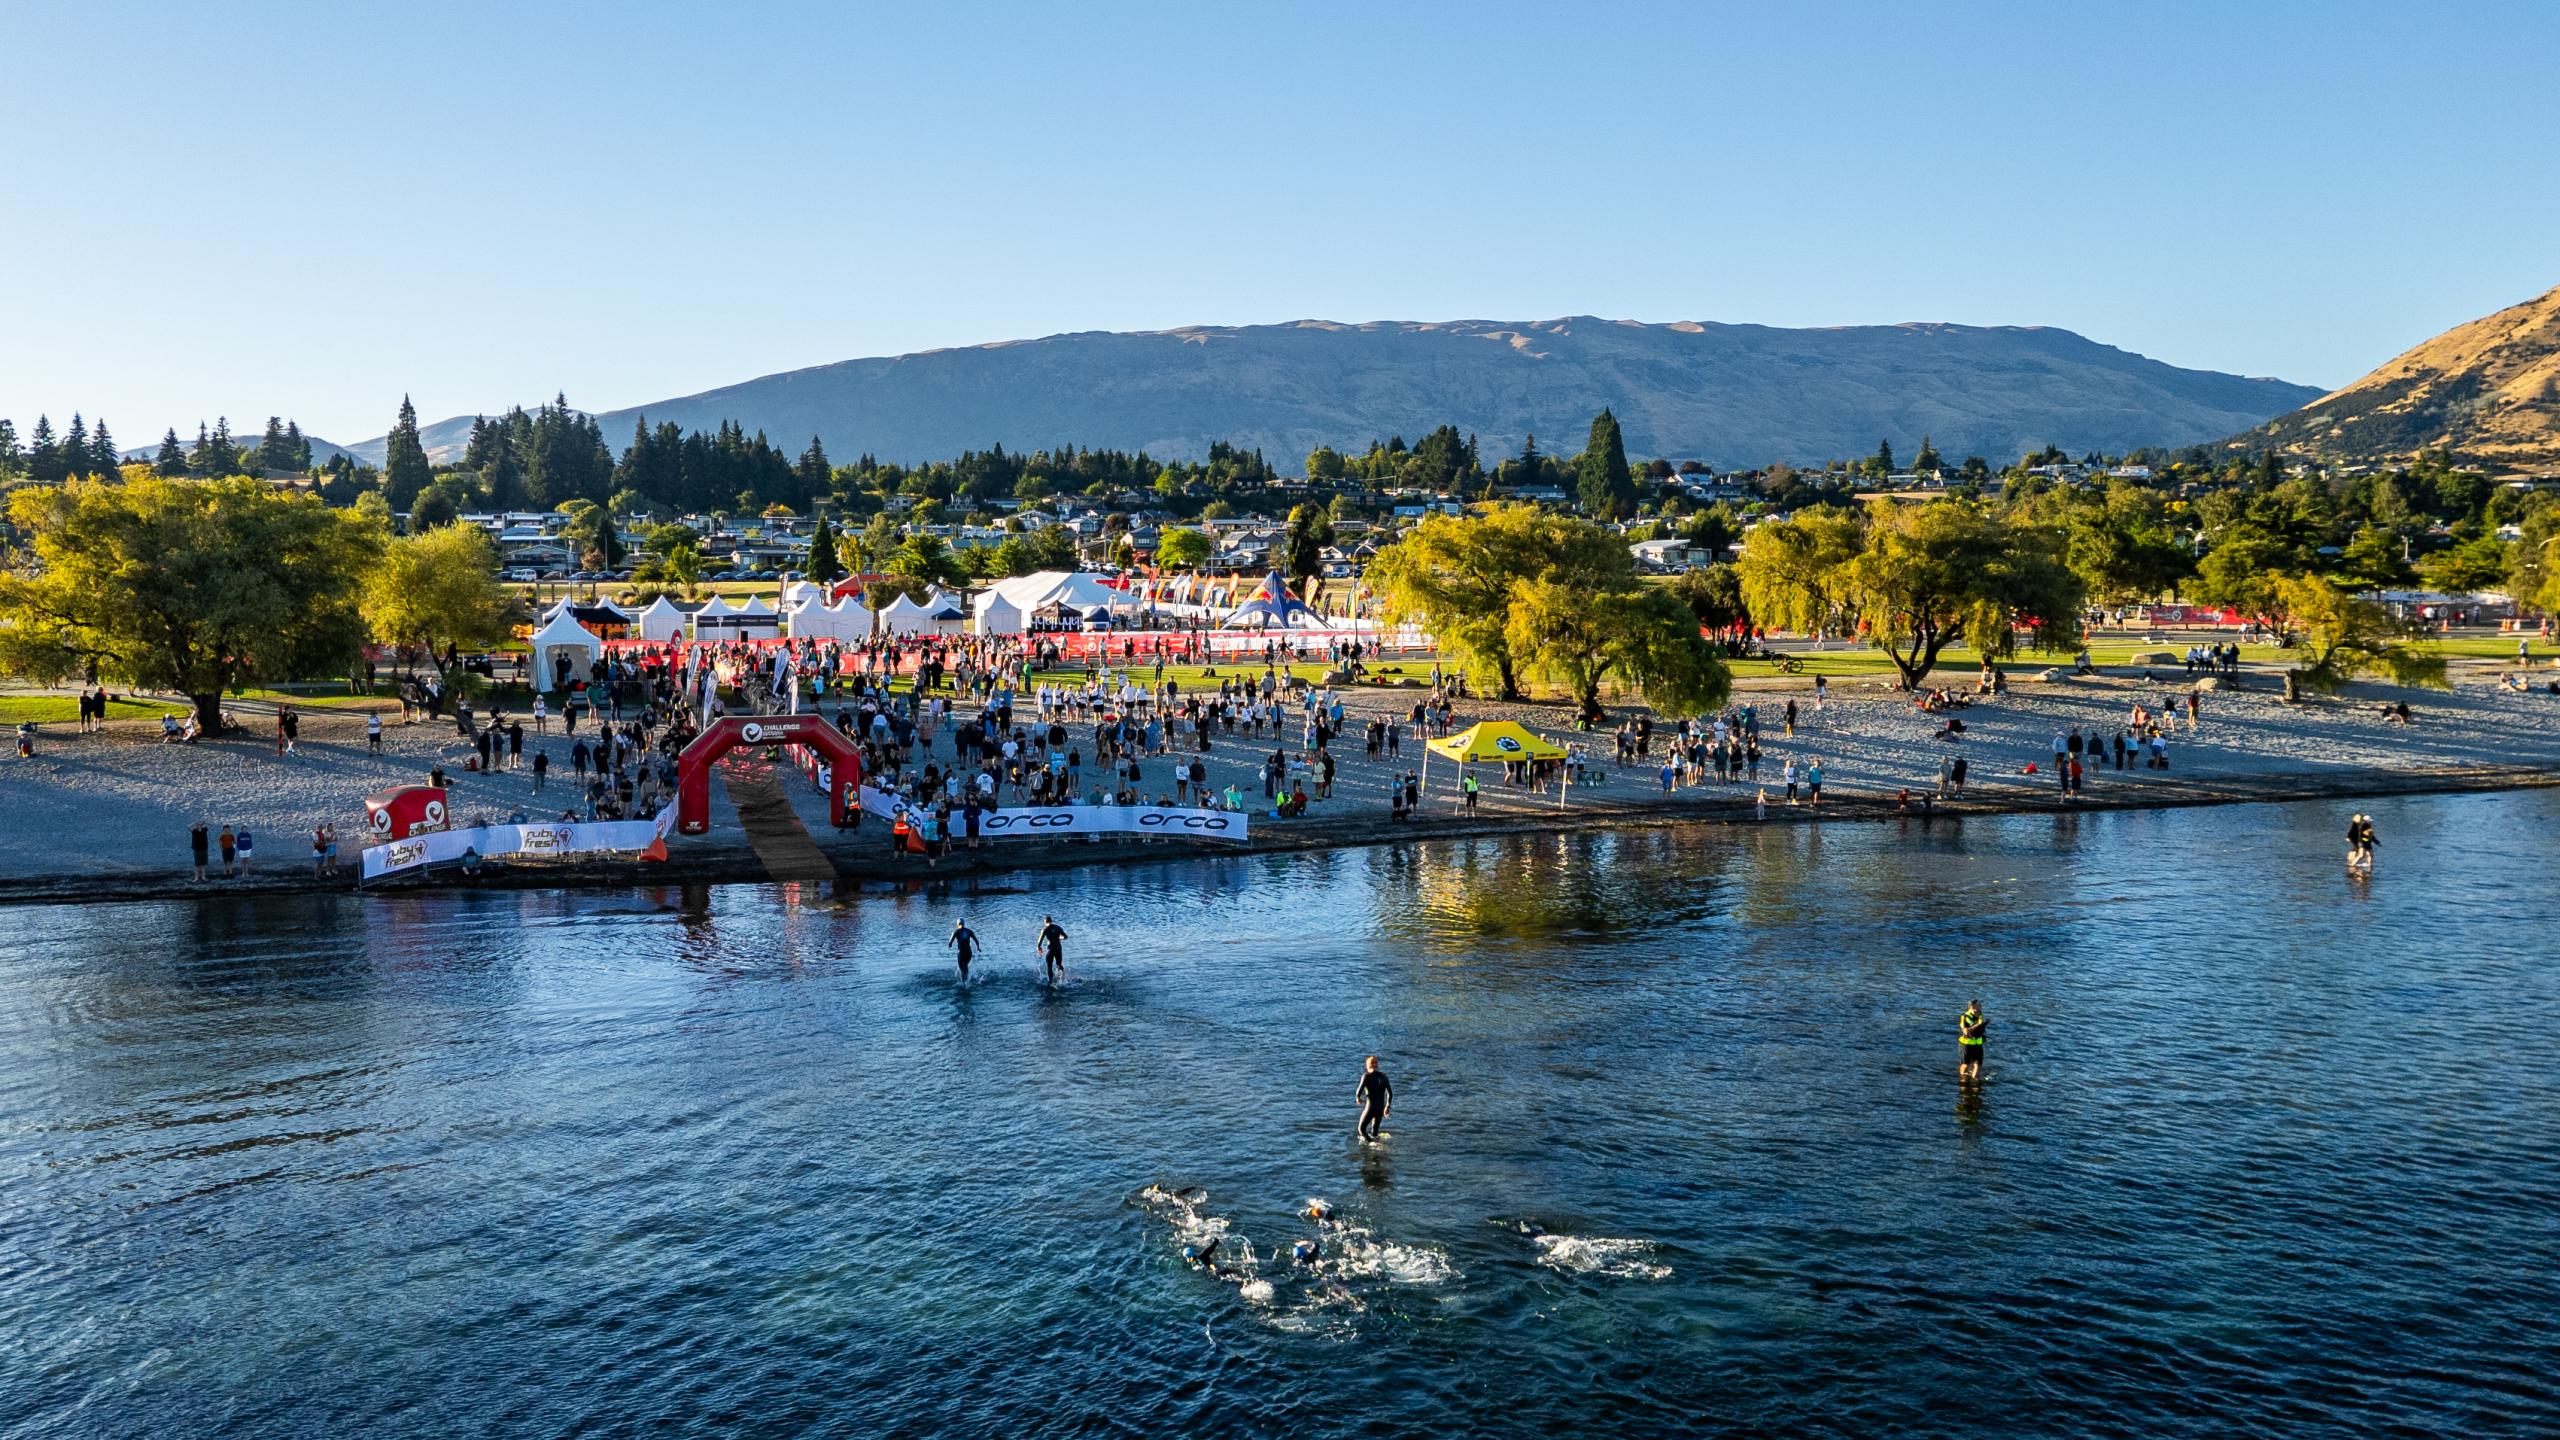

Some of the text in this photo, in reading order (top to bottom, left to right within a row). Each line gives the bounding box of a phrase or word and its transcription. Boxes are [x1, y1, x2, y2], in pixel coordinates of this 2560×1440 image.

[985, 813, 1074, 829] orca
[1138, 813, 1229, 830] orca
[526, 828, 559, 839] ruby
[524, 837, 560, 848] fresh
[387, 844, 414, 858] ruby
[385, 853, 416, 868] fresh
